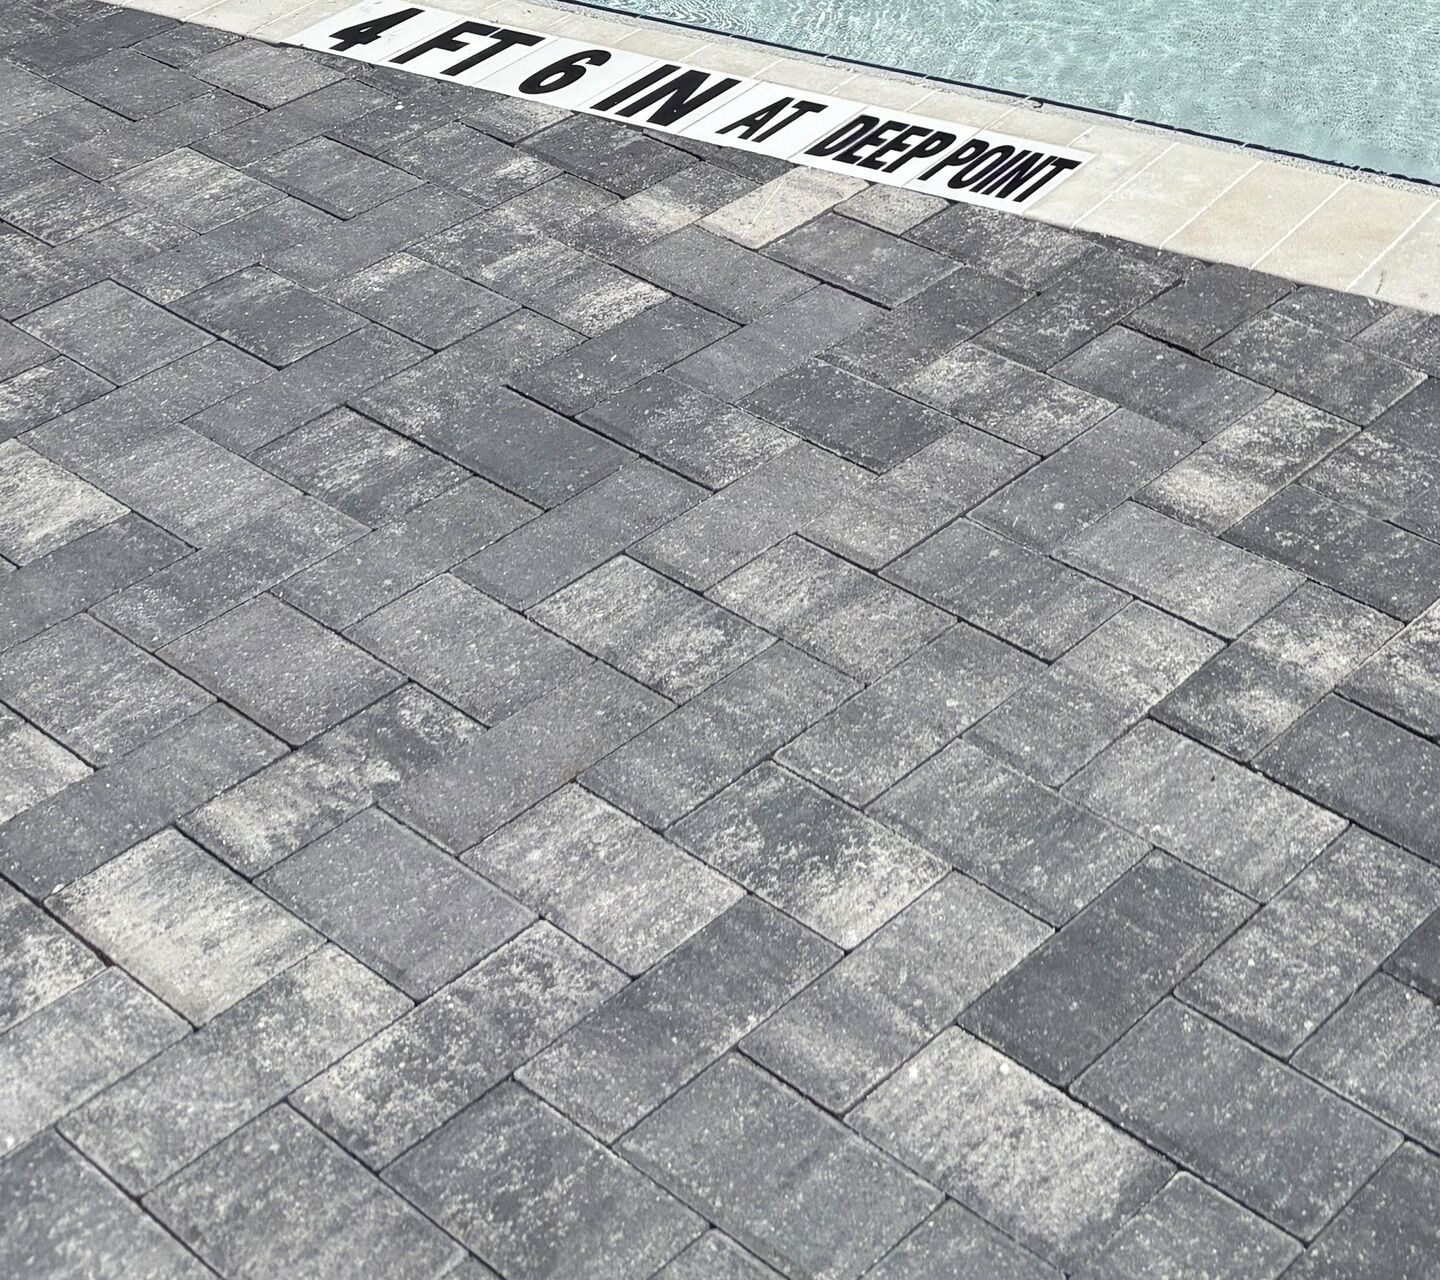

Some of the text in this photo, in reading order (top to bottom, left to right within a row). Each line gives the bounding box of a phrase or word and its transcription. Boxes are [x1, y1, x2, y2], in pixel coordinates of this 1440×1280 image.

[329, 7, 1082, 204] 4 FT 6 IN AT DEEP POINT
